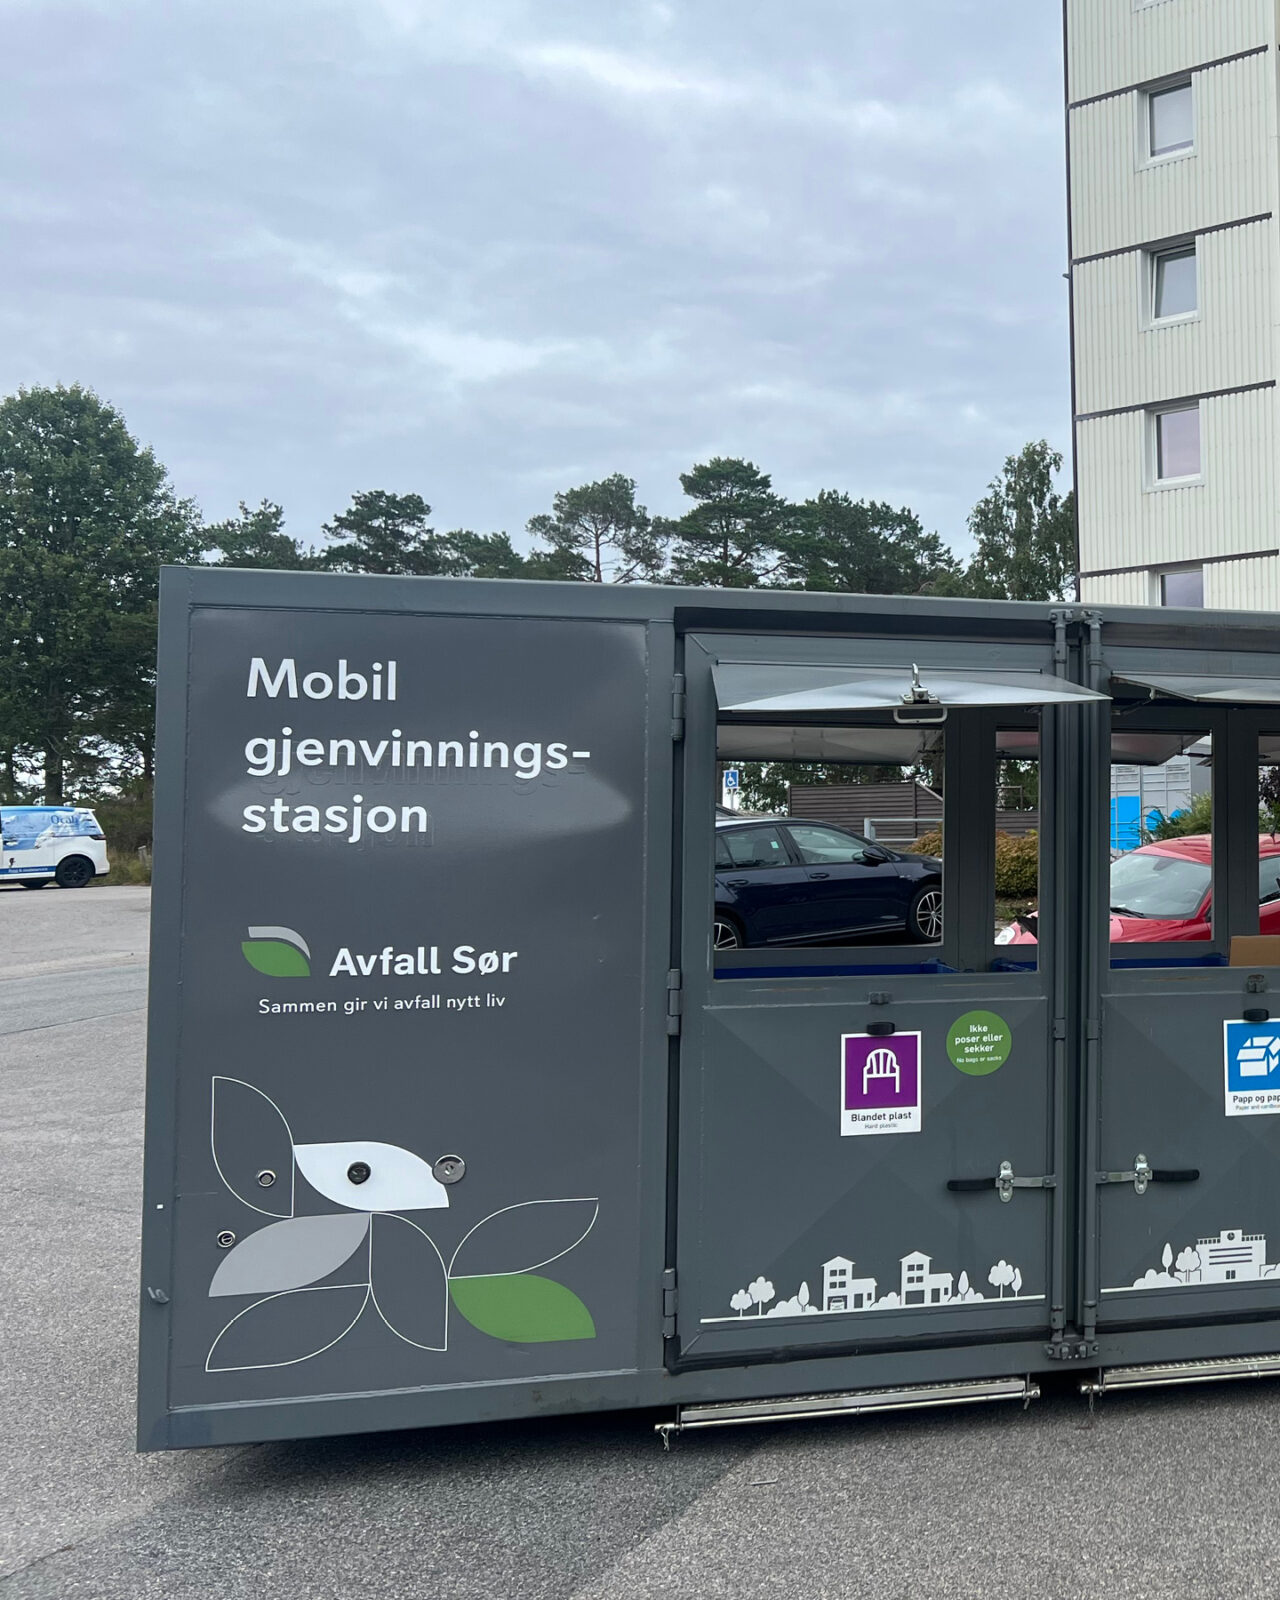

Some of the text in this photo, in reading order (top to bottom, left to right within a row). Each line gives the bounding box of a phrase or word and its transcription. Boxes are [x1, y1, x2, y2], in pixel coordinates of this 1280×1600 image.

[246, 657, 398, 702] Mobil
[243, 727, 592, 778] gjenvinnings-
[242, 794, 428, 844] stasjon
[329, 945, 518, 978] Avfall Sør
[258, 992, 506, 1016] Sammen gir vi avfall nytt liv
[970, 1024, 988, 1033] Ikke
[954, 1033, 1003, 1046] poser eller
[964, 1045, 994, 1053] sekker
[1233, 1095, 1253, 1104] Papp
[1255, 1095, 1265, 1103] og
[851, 1112, 912, 1122] Blandet plast
